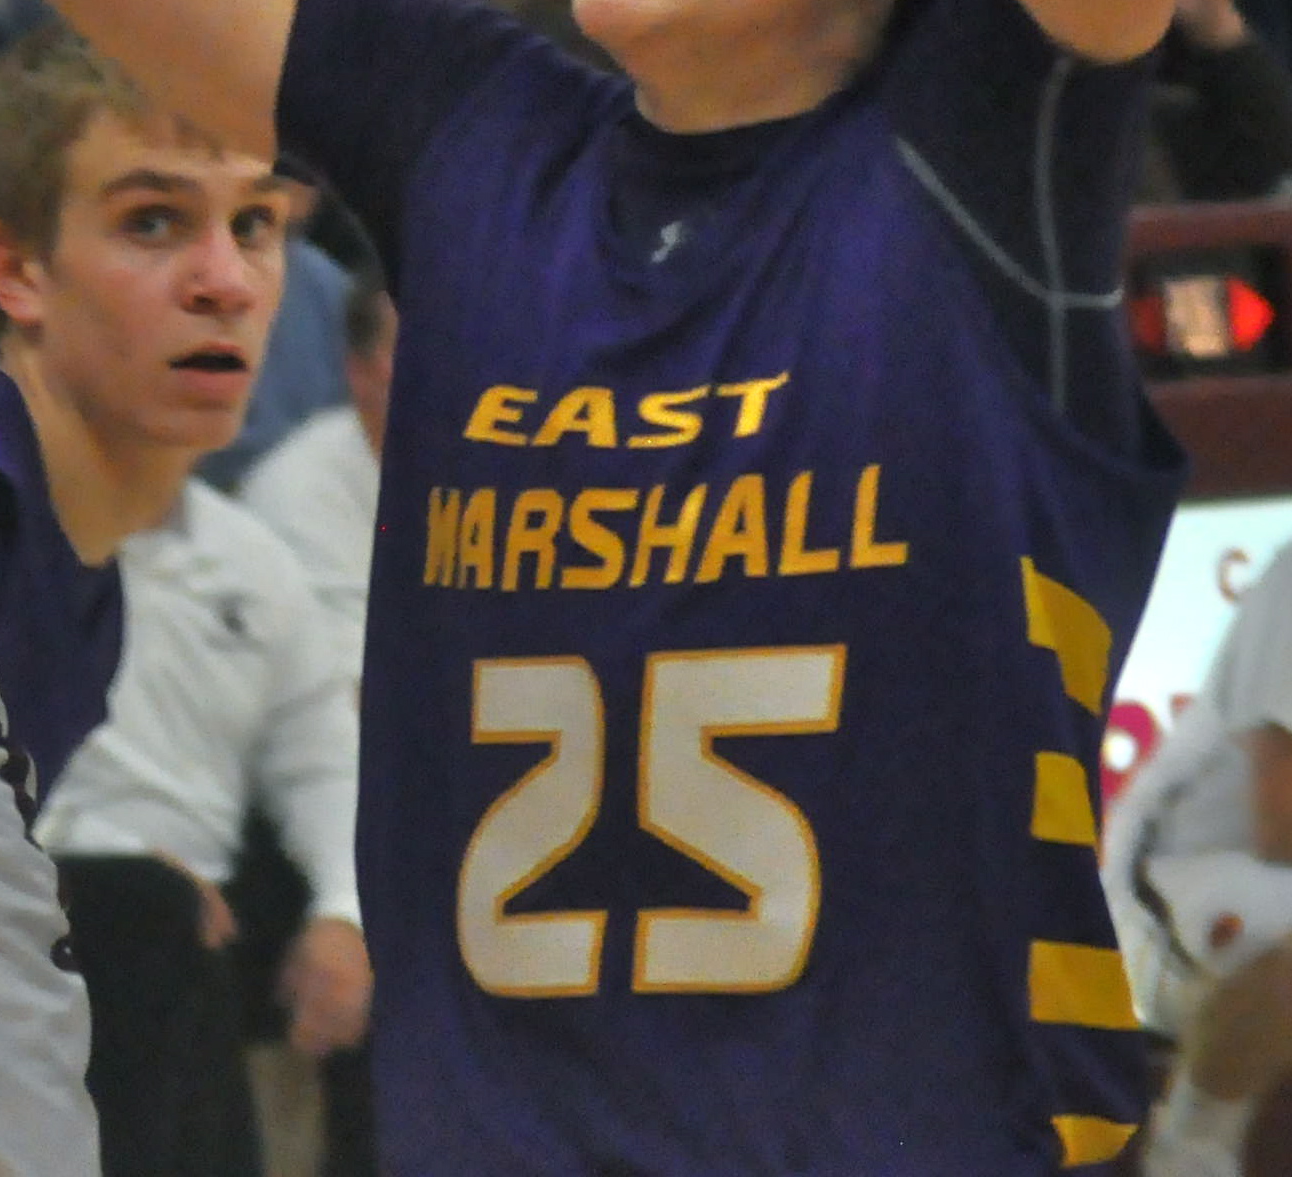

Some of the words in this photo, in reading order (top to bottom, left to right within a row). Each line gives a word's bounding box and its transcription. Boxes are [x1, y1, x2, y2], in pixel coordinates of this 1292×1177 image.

[462, 370, 790, 450] EAST
[423, 463, 909, 592] MARSHALL
[456, 643, 847, 1000] 25
